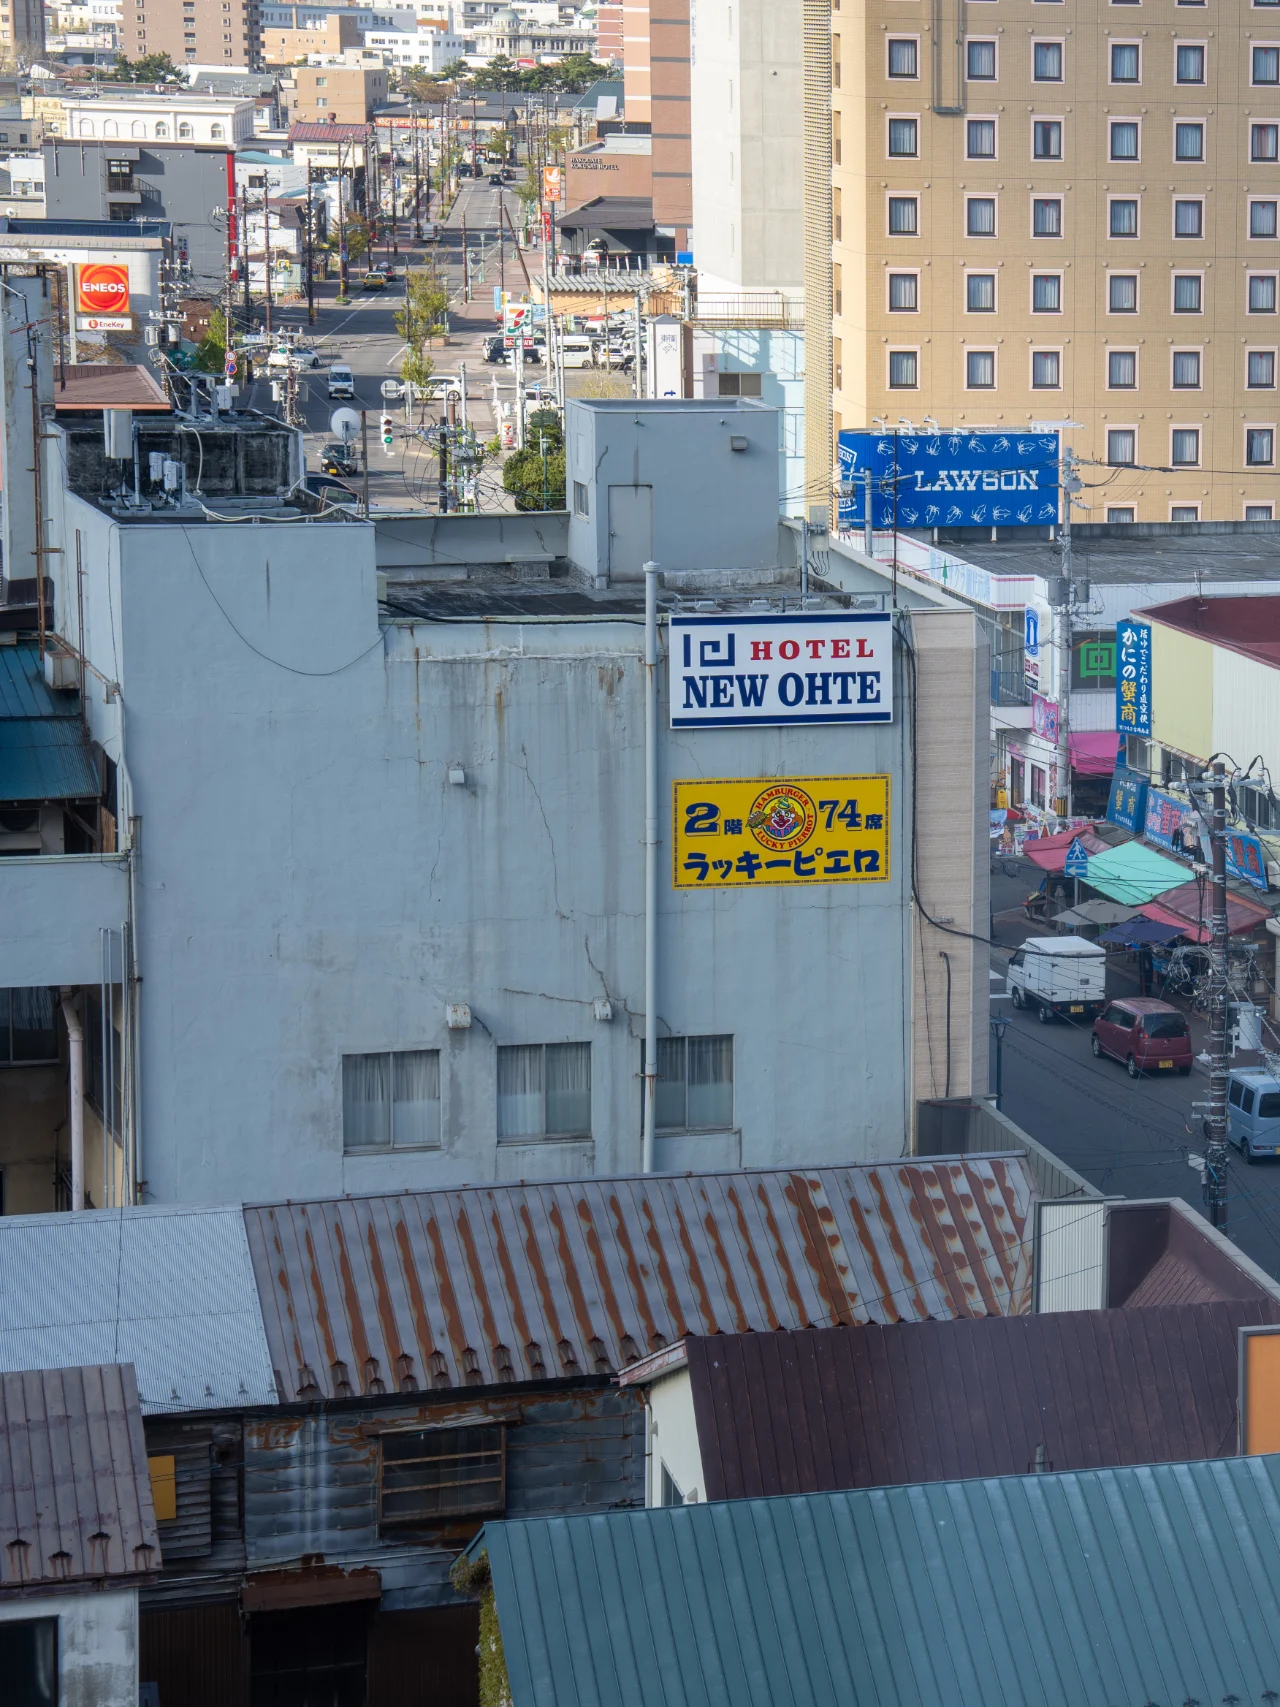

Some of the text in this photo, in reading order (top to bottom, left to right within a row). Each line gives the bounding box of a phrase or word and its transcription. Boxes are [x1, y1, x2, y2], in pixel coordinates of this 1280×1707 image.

[82, 282, 125, 293] ENEOS
[99, 321, 124, 329] EneKey
[914, 469, 1040, 491] LAWSON
[750, 638, 874, 660] HOTEL
[682, 670, 881, 709] NEW OHTE
[1120, 627, 1139, 726] かにの蟹商
[755, 787, 810, 812] HAMBURGER
[818, 799, 884, 833] 74席
[684, 801, 744, 838] 2階
[756, 813, 815, 850] LUCKY PIERROT
[683, 847, 881, 881] ラッキーピエロ
